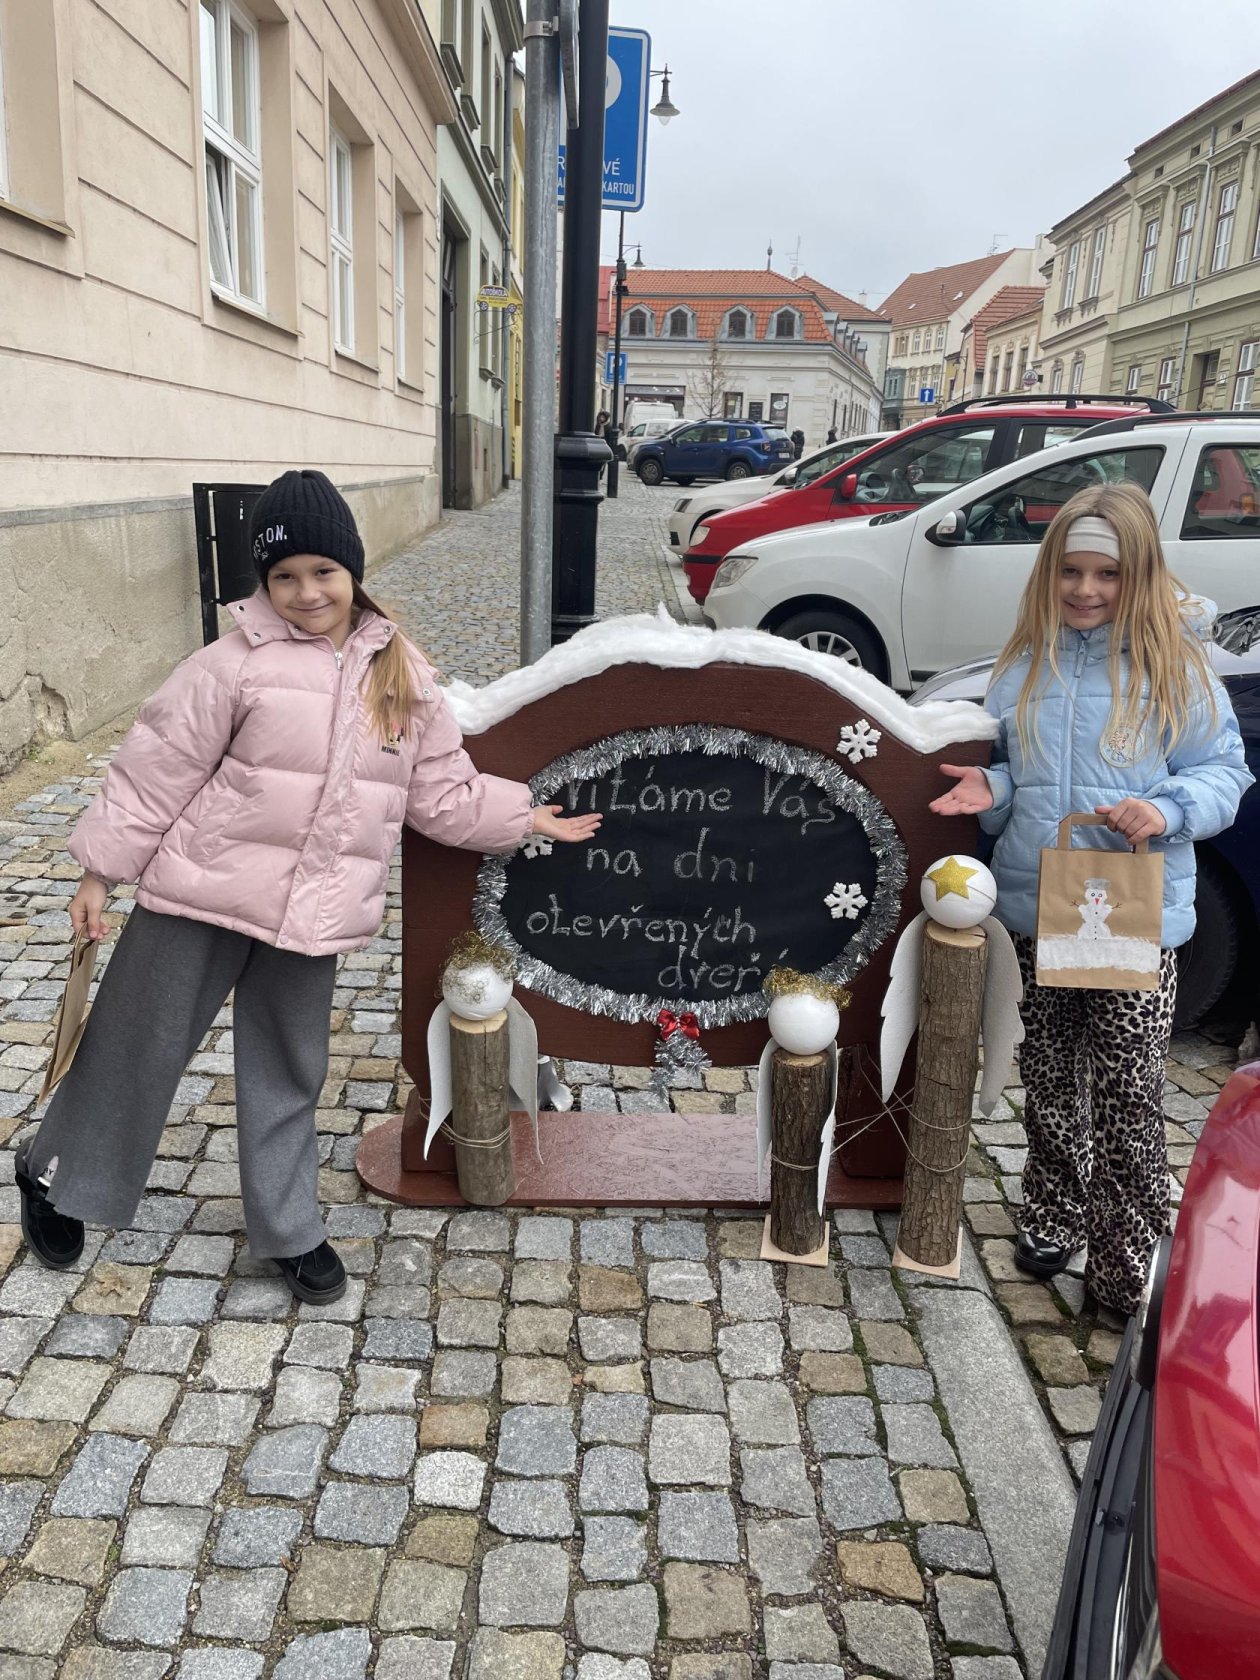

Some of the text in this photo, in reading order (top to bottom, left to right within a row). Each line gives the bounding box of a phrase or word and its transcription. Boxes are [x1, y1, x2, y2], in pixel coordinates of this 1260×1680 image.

[602, 181, 635, 195] KARTOU
[586, 848, 642, 878] na
[657, 945, 790, 992] dveř
